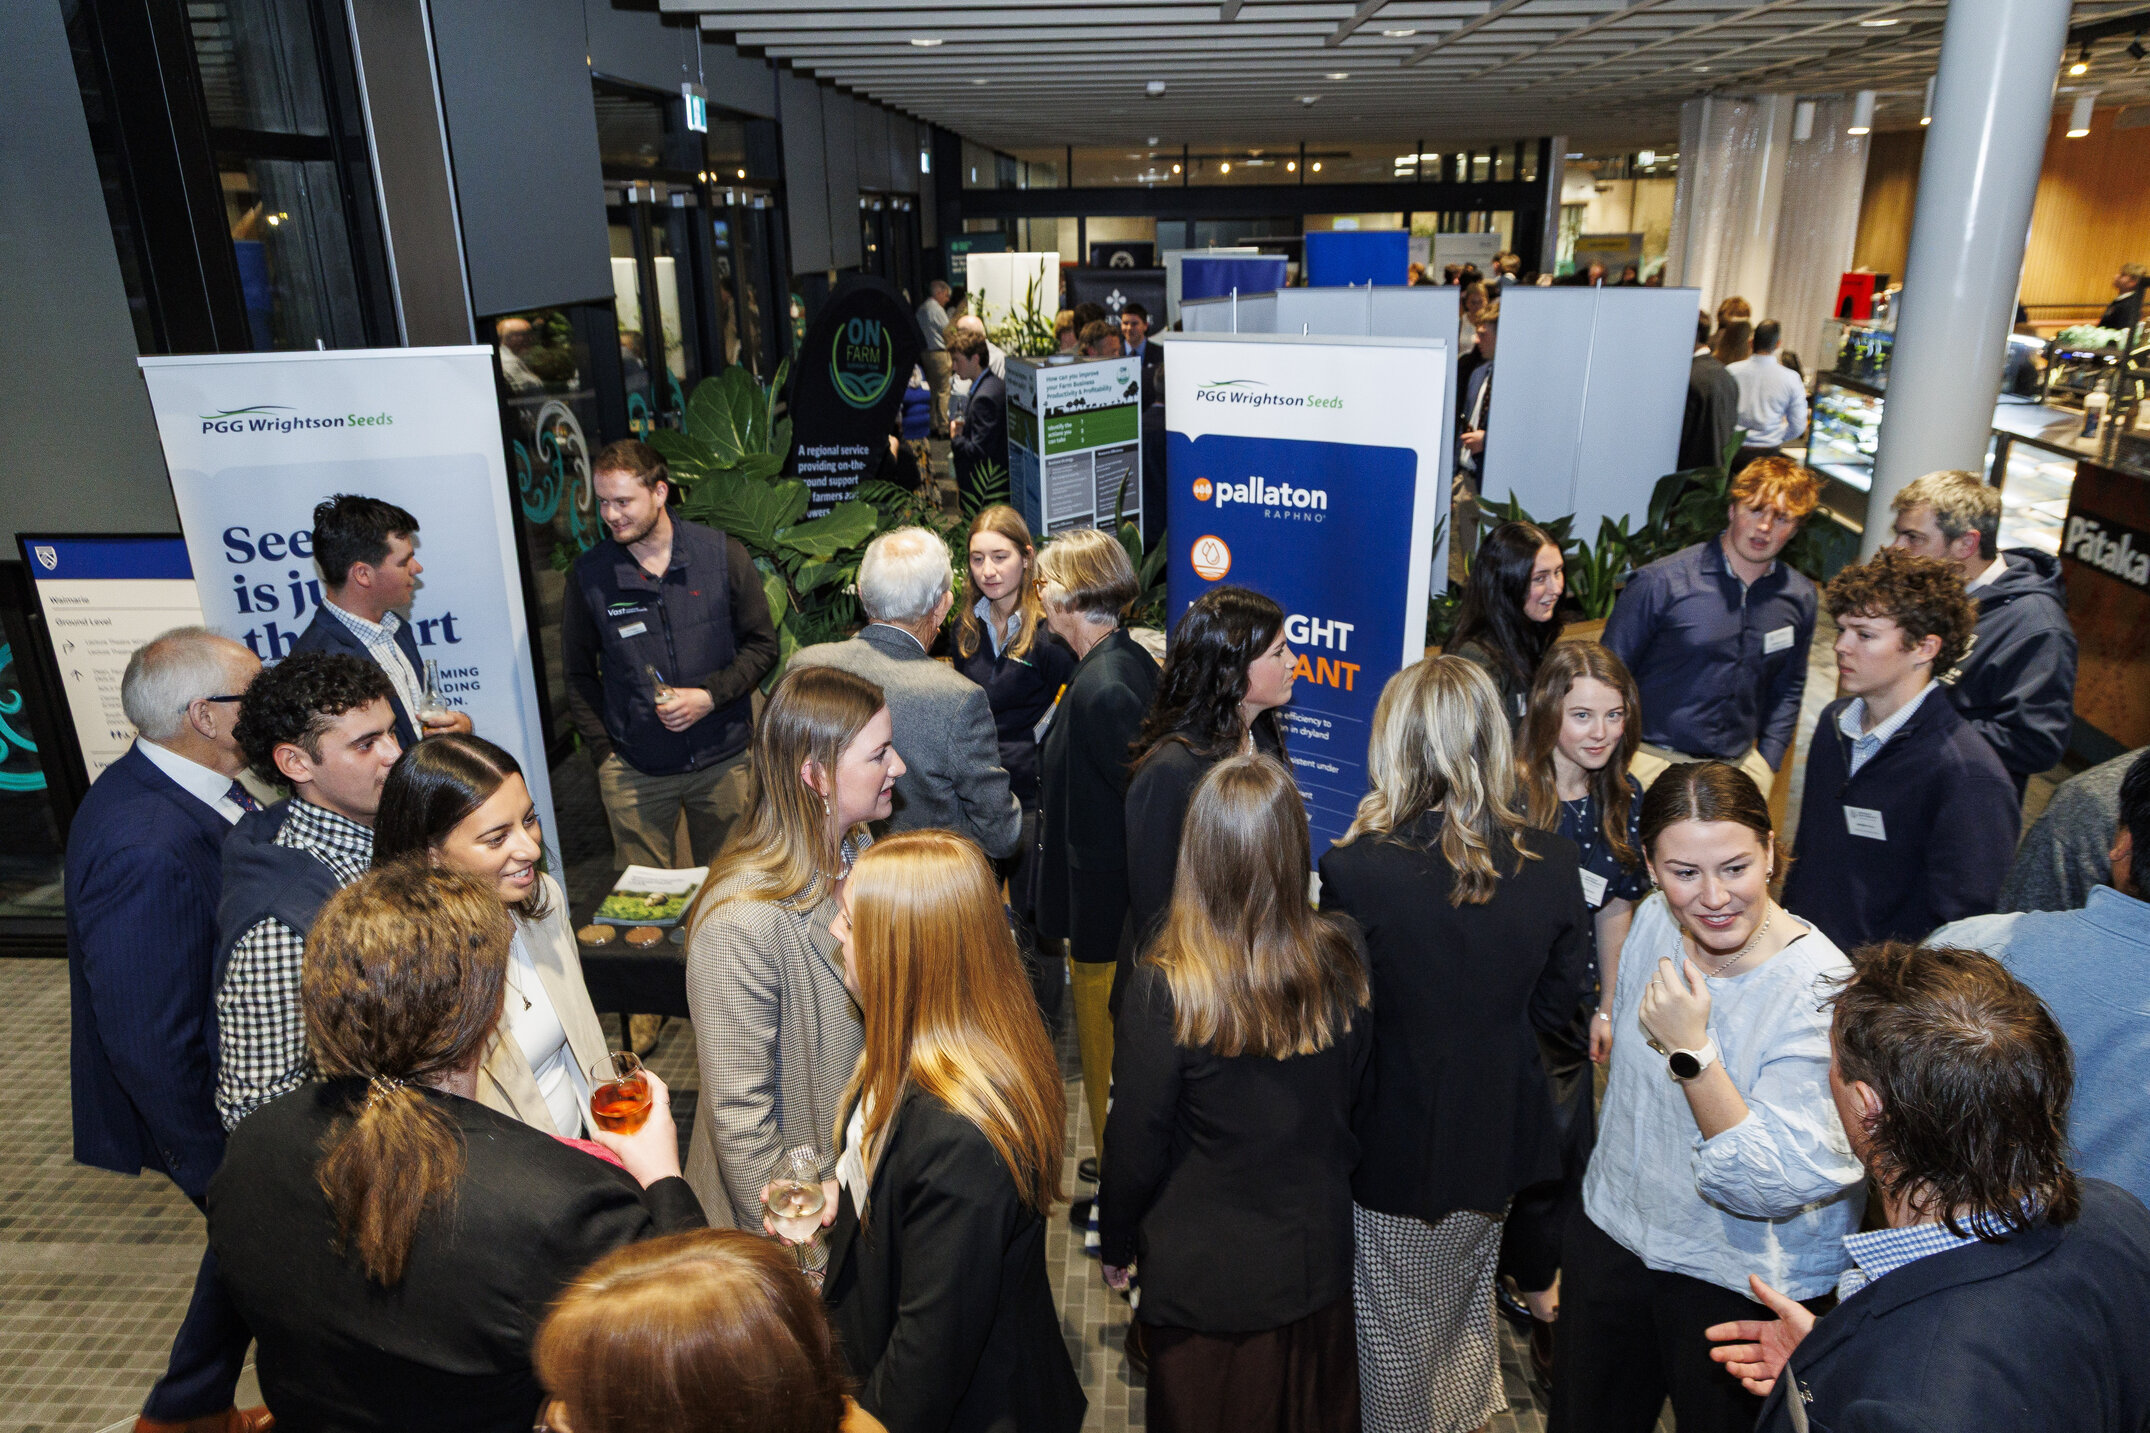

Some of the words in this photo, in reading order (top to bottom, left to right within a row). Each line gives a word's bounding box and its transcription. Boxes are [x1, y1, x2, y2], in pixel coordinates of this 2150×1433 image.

[848, 317, 880, 347] ON
[846, 345, 880, 363] FARM
[1073, 379, 1095, 387] Business
[1079, 371, 1099, 379] improve
[1046, 390, 1078, 399] Productivity
[1083, 384, 1112, 394] Profitability
[1196, 390, 1226, 403] PGG
[1230, 391, 1304, 408] Wrightson
[1306, 394, 1344, 409] Seeds
[202, 420, 243, 434] PGG
[249, 416, 344, 433] Wrightson
[347, 412, 393, 427] Seeds
[798, 444, 805, 456] A
[807, 444, 840, 458] regional
[840, 444, 869, 456] service
[798, 460, 837, 474] providing
[837, 459, 866, 470] on-the-
[828, 474, 858, 488] support
[812, 491, 843, 503] farmers
[1215, 475, 1328, 510] pallaton
[1264, 509, 1325, 523] RAPHNO
[223, 526, 314, 564] See
[2063, 515, 2150, 585] Pātaka
[233, 574, 279, 614] is
[288, 570, 321, 620] ju
[55, 617, 88, 627] Ground
[89, 617, 112, 626] Level
[242, 621, 300, 661] th
[440, 667, 479, 679] MING
[1293, 653, 1360, 692] ANT
[438, 681, 480, 693] DING
[1284, 711, 1322, 728] efficiency
[1323, 719, 1332, 729] to
[1290, 725, 1298, 734] in
[1299, 726, 1330, 741] dryland
[1316, 760, 1339, 774] under
